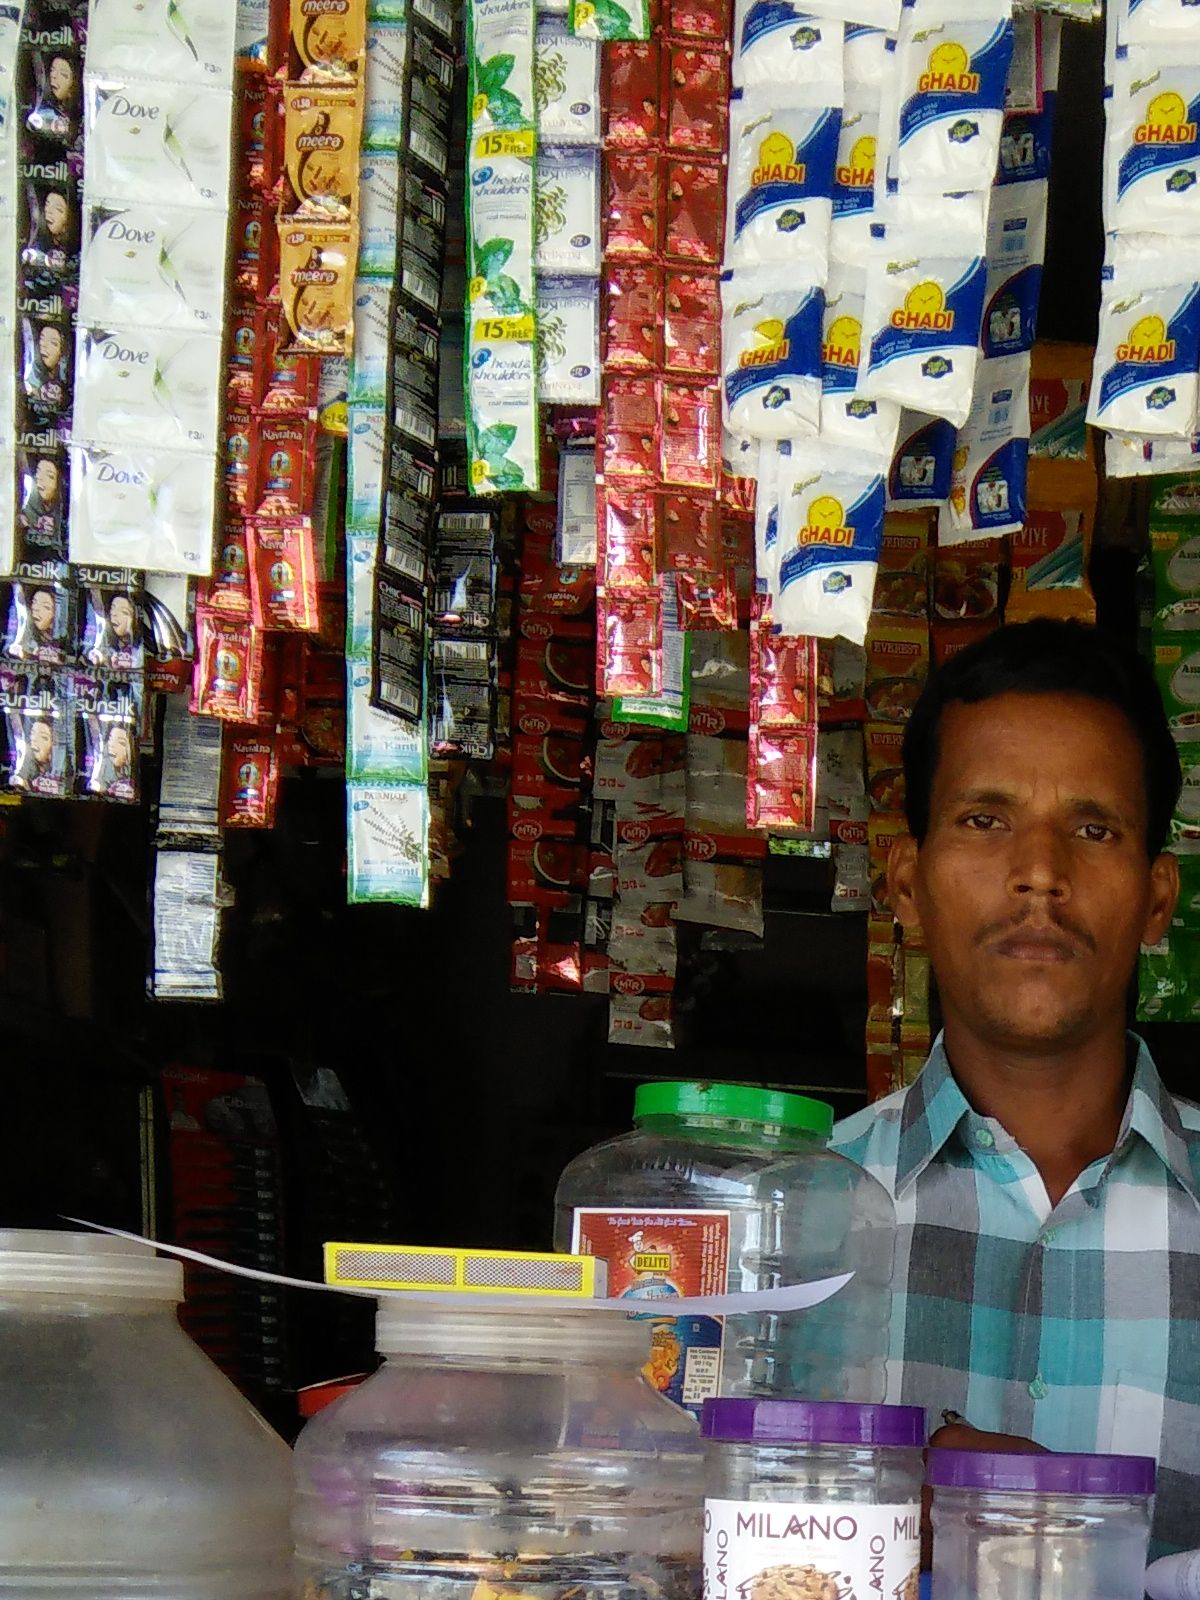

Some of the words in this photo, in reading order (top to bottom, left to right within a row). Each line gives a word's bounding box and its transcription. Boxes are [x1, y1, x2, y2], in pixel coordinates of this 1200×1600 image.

[918, 72, 980, 93] GHADI
[111, 95, 160, 119] Dove
[297, 135, 342, 148] meera
[1134, 122, 1194, 144] GHADI
[482, 135, 502, 154] 15
[751, 164, 806, 187] GHADI
[836, 165, 875, 187] GHA
[106, 219, 156, 244] Dove
[290, 269, 334, 282] meera
[482, 321, 504, 339] 15
[891, 309, 954, 331] GHADI
[102, 341, 150, 364] Dove
[823, 344, 861, 368] GHA
[1116, 343, 1175, 365] GHADI
[472, 369, 531, 381] shoulders
[97, 462, 146, 485] Dove
[799, 525, 854, 547] GHADI
[1011, 527, 1048, 547] EVIVE
[79, 566, 140, 586] sunsilk
[525, 623, 551, 637] MTR
[873, 642, 920, 656] EVEREST
[76, 696, 136, 717] sunsilk
[522, 717, 546, 731] MTR
[690, 712, 717, 730] MTR
[516, 824, 540, 837] MTR
[623, 826, 649, 841] MTR
[385, 865, 419, 877] Kanti
[618, 979, 643, 993] MTR
[636, 1255, 670, 1270] DELITE
[736, 1511, 858, 1541] MILANO
[893, 1516, 920, 1541] MIL
